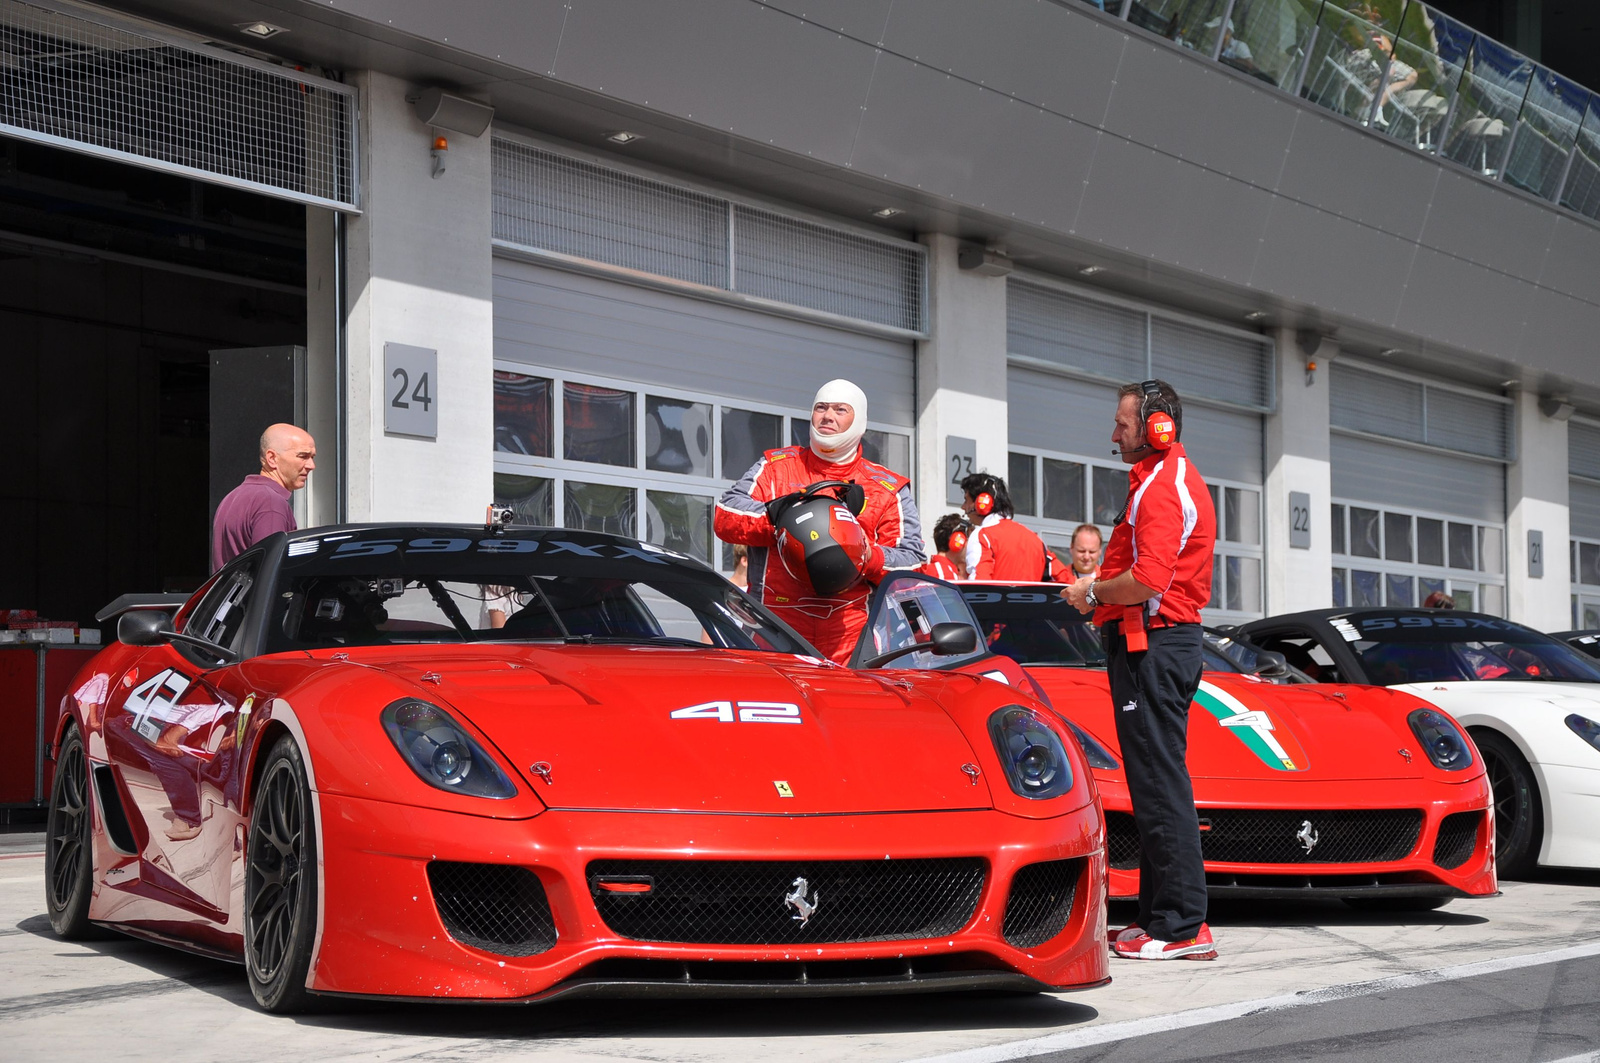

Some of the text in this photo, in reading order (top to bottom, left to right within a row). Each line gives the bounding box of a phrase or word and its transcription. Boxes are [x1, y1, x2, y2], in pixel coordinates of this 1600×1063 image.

[392, 368, 432, 411] 24
[1293, 506, 1309, 531] 22
[329, 538, 671, 565] 599XX
[1532, 542, 1541, 564] 21
[122, 666, 193, 744] 42
[669, 700, 803, 724] 42
[1218, 710, 1276, 731] 4
